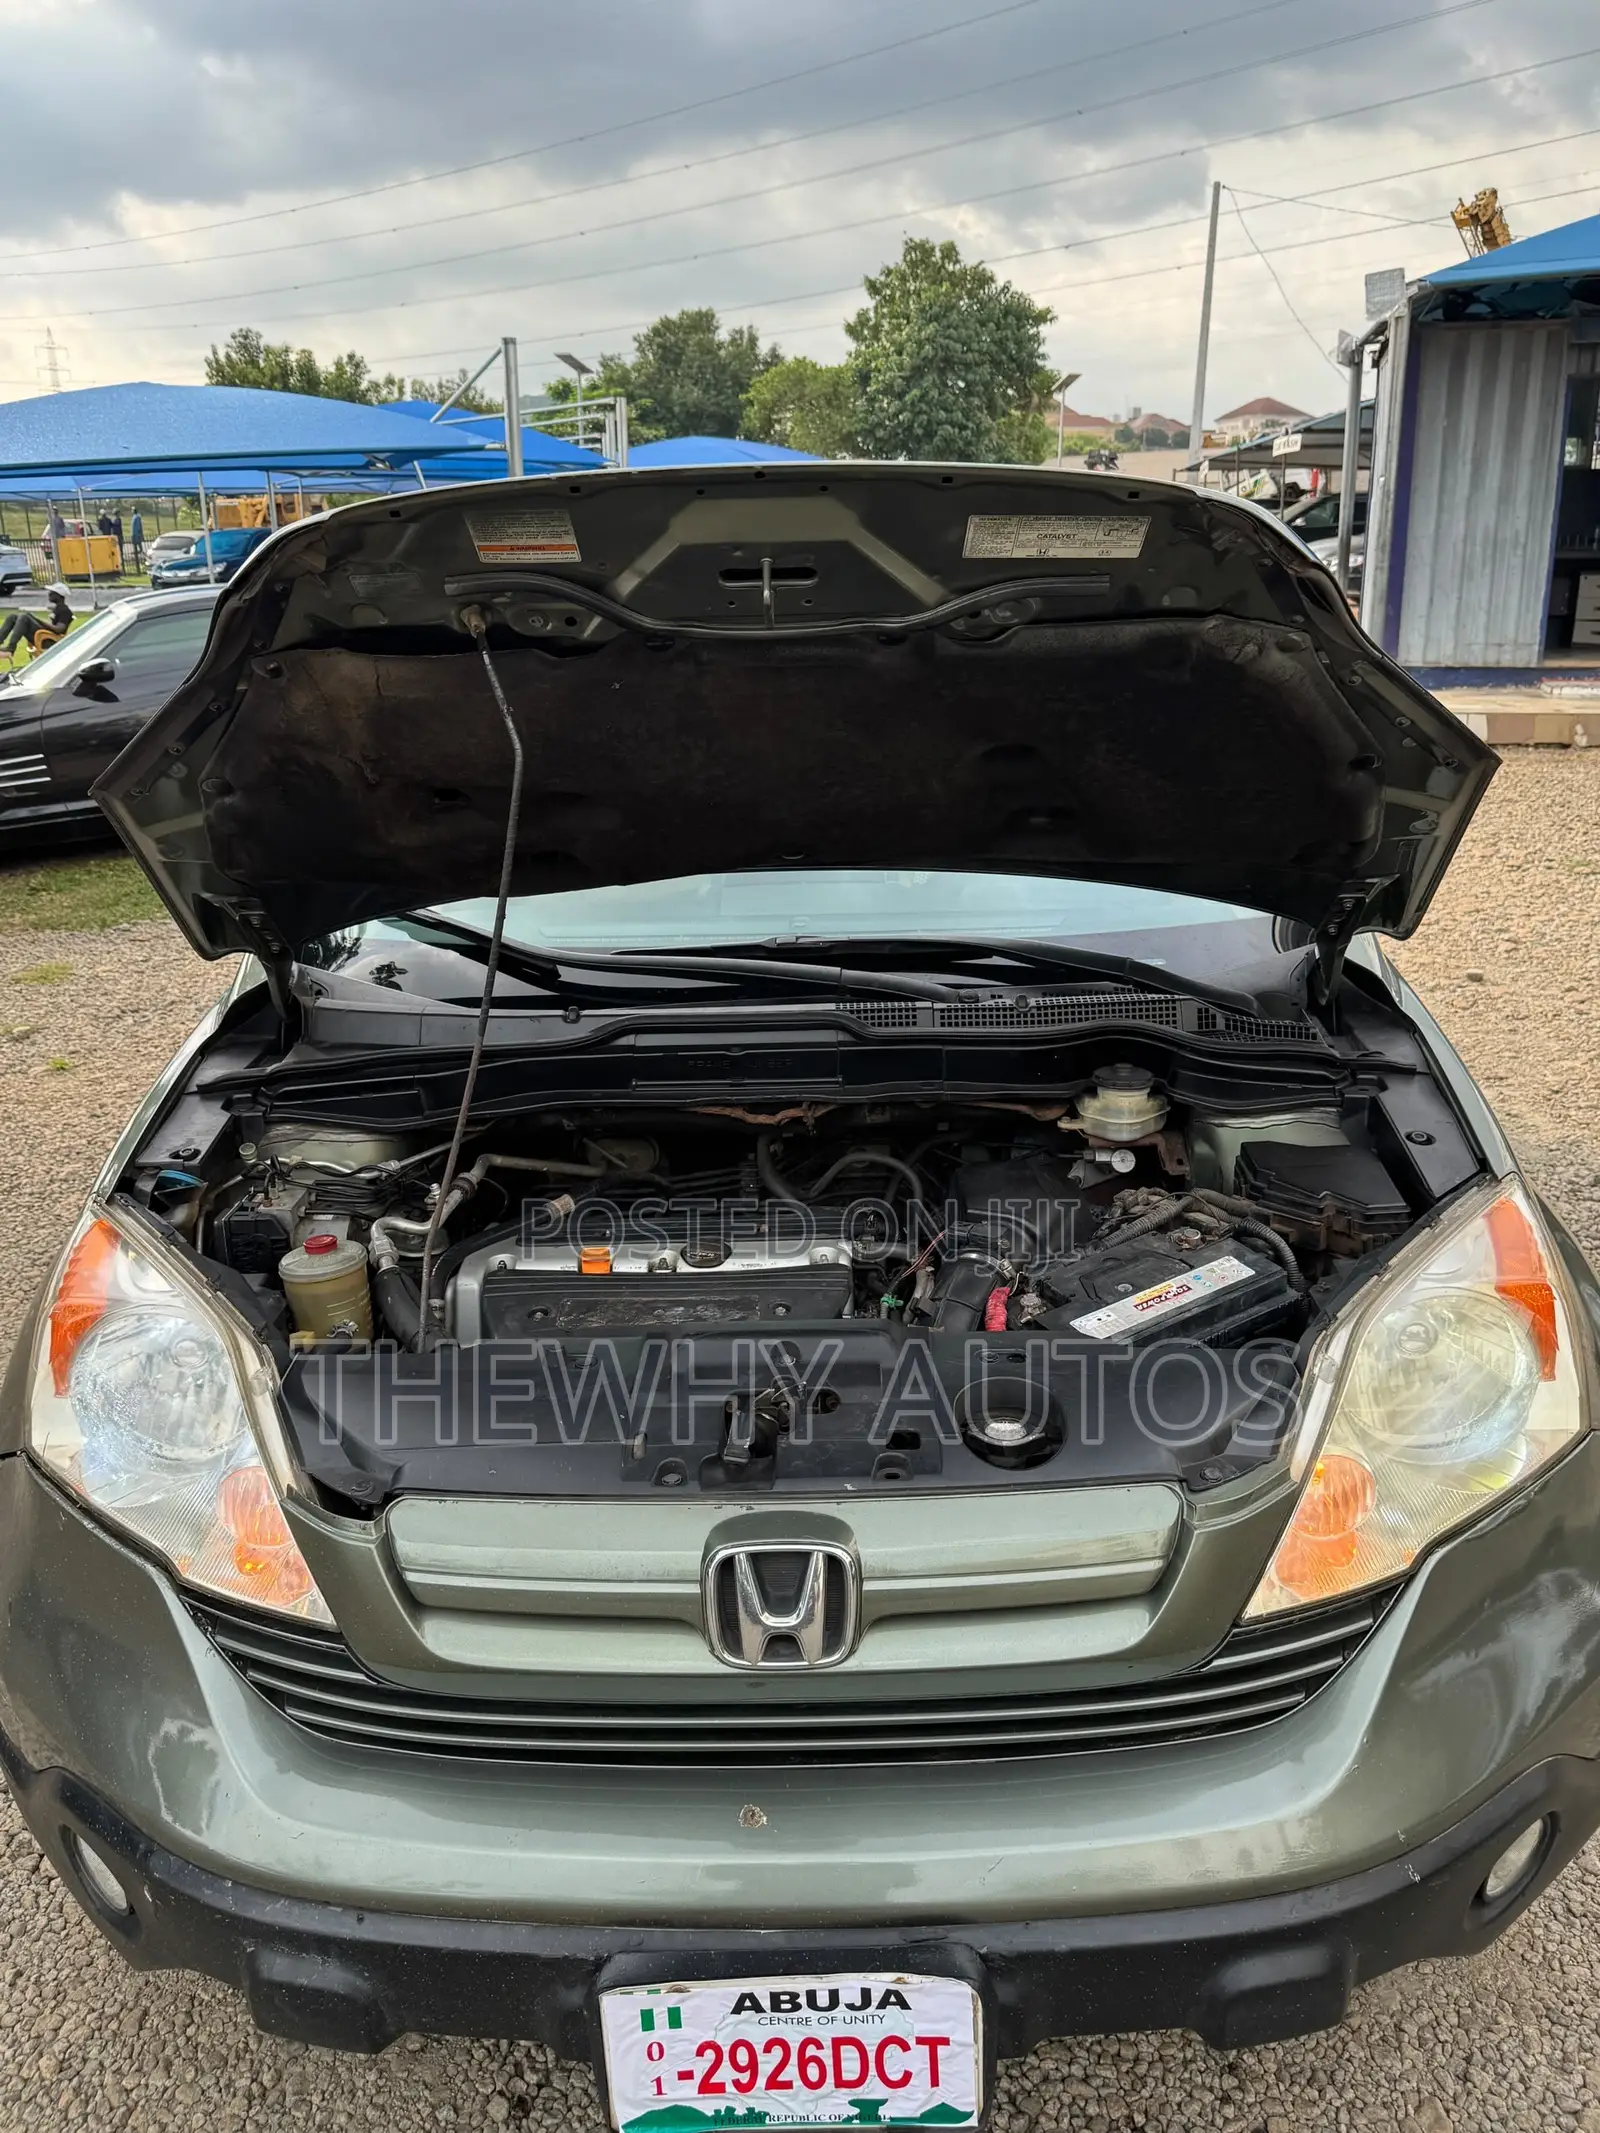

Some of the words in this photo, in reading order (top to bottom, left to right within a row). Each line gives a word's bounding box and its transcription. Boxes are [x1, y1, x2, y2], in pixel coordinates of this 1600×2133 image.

[730, 1987, 912, 2015] ABUJA
[757, 2016, 811, 2026] CENTRE
[817, 2015, 838, 2026] OF
[843, 2014, 886, 2025] UNITY
[769, 2114, 827, 2123] REPUBLIC
[828, 2113, 844, 2122] OF
